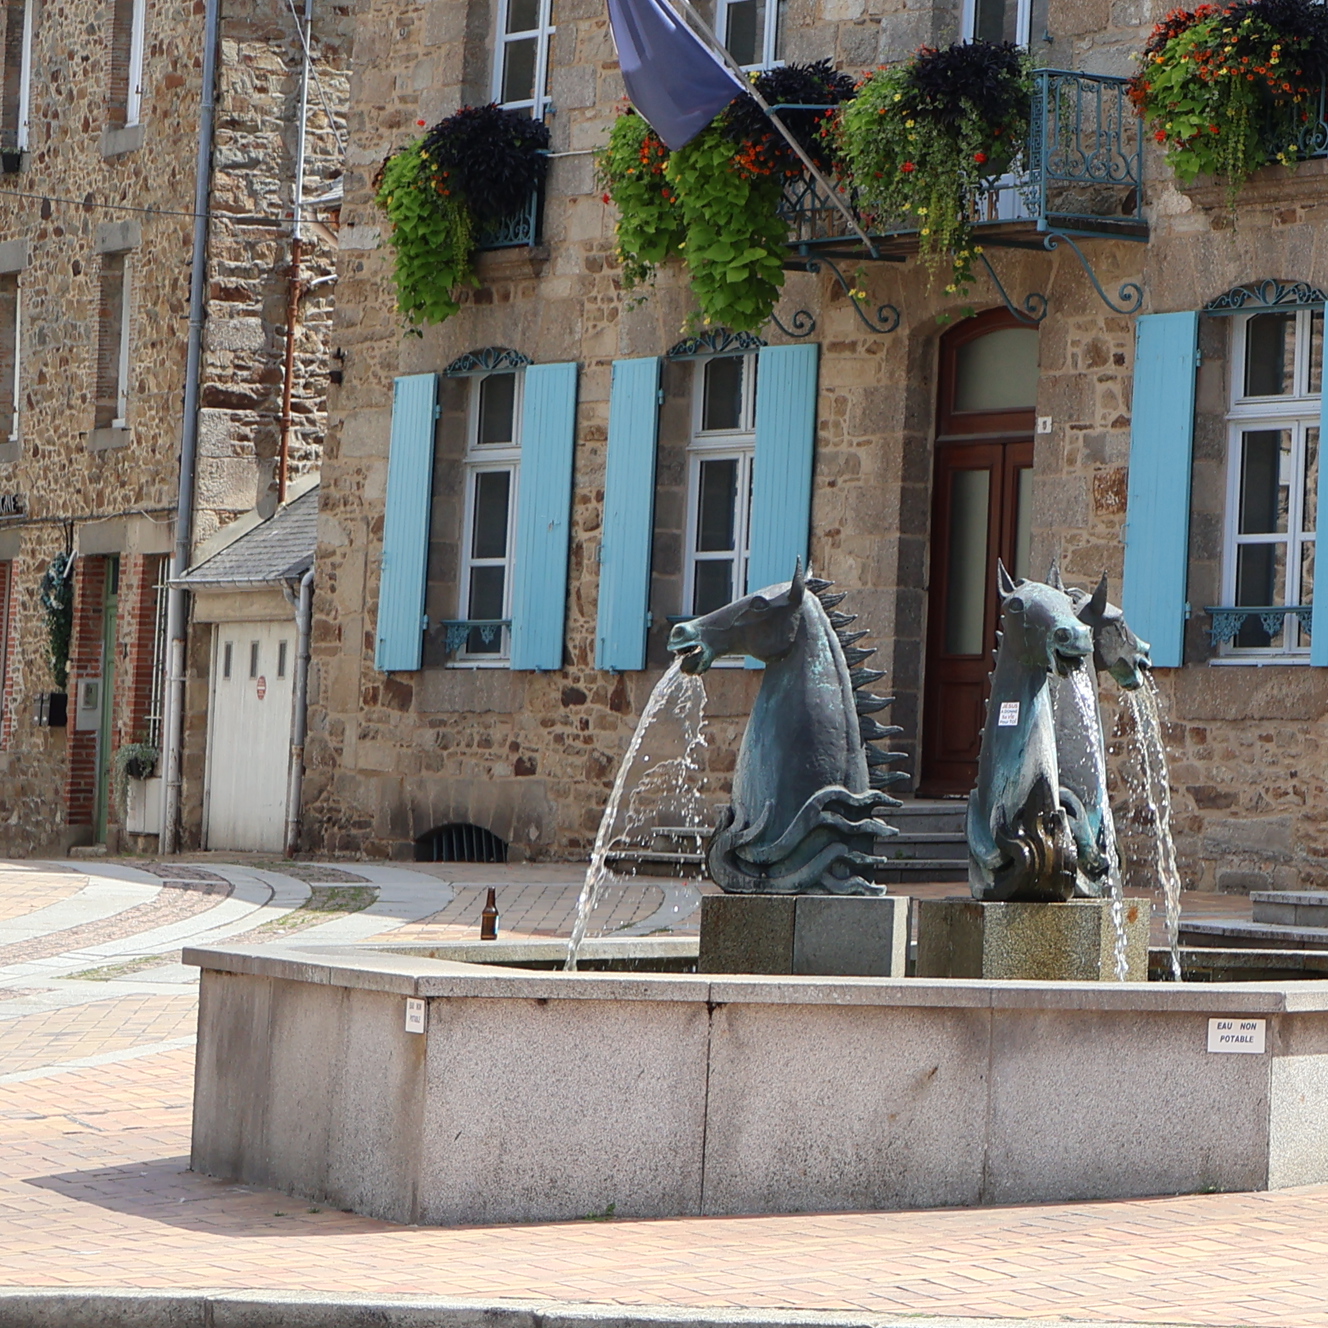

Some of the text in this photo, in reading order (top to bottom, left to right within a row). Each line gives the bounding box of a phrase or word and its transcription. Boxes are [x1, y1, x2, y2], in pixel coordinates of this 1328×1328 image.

[1217, 1022, 1257, 1030] EAU NON
[1219, 1035, 1254, 1043] POTABLE
